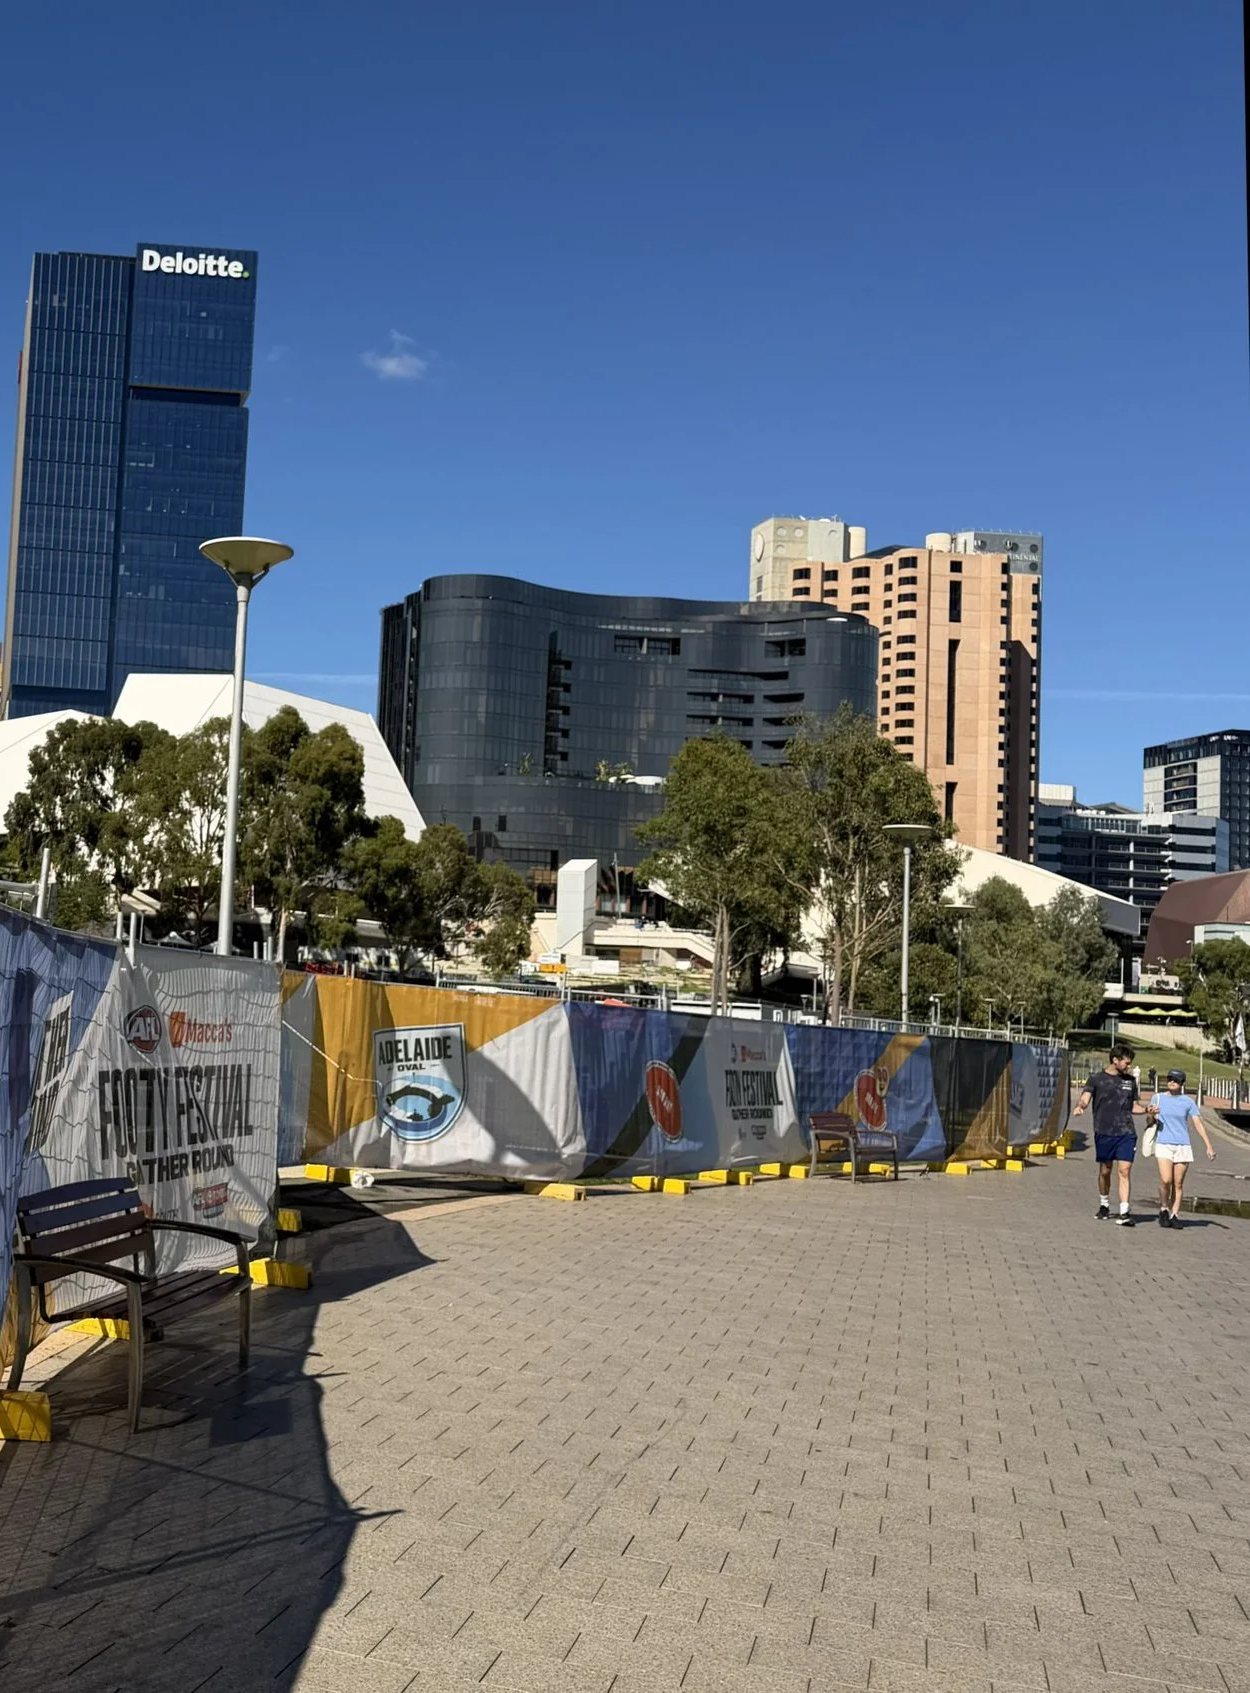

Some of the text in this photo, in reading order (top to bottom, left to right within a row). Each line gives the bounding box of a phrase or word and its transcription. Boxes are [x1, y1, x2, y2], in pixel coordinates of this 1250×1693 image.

[185, 1019, 232, 1043] Macca's
[379, 1036, 452, 1066] ADELAIDE
[397, 1063, 426, 1072] OVAL
[99, 1067, 169, 1160] FOOTY
[175, 1063, 253, 1147] FESTIVAL
[127, 1144, 234, 1187] GATHER ROUND
